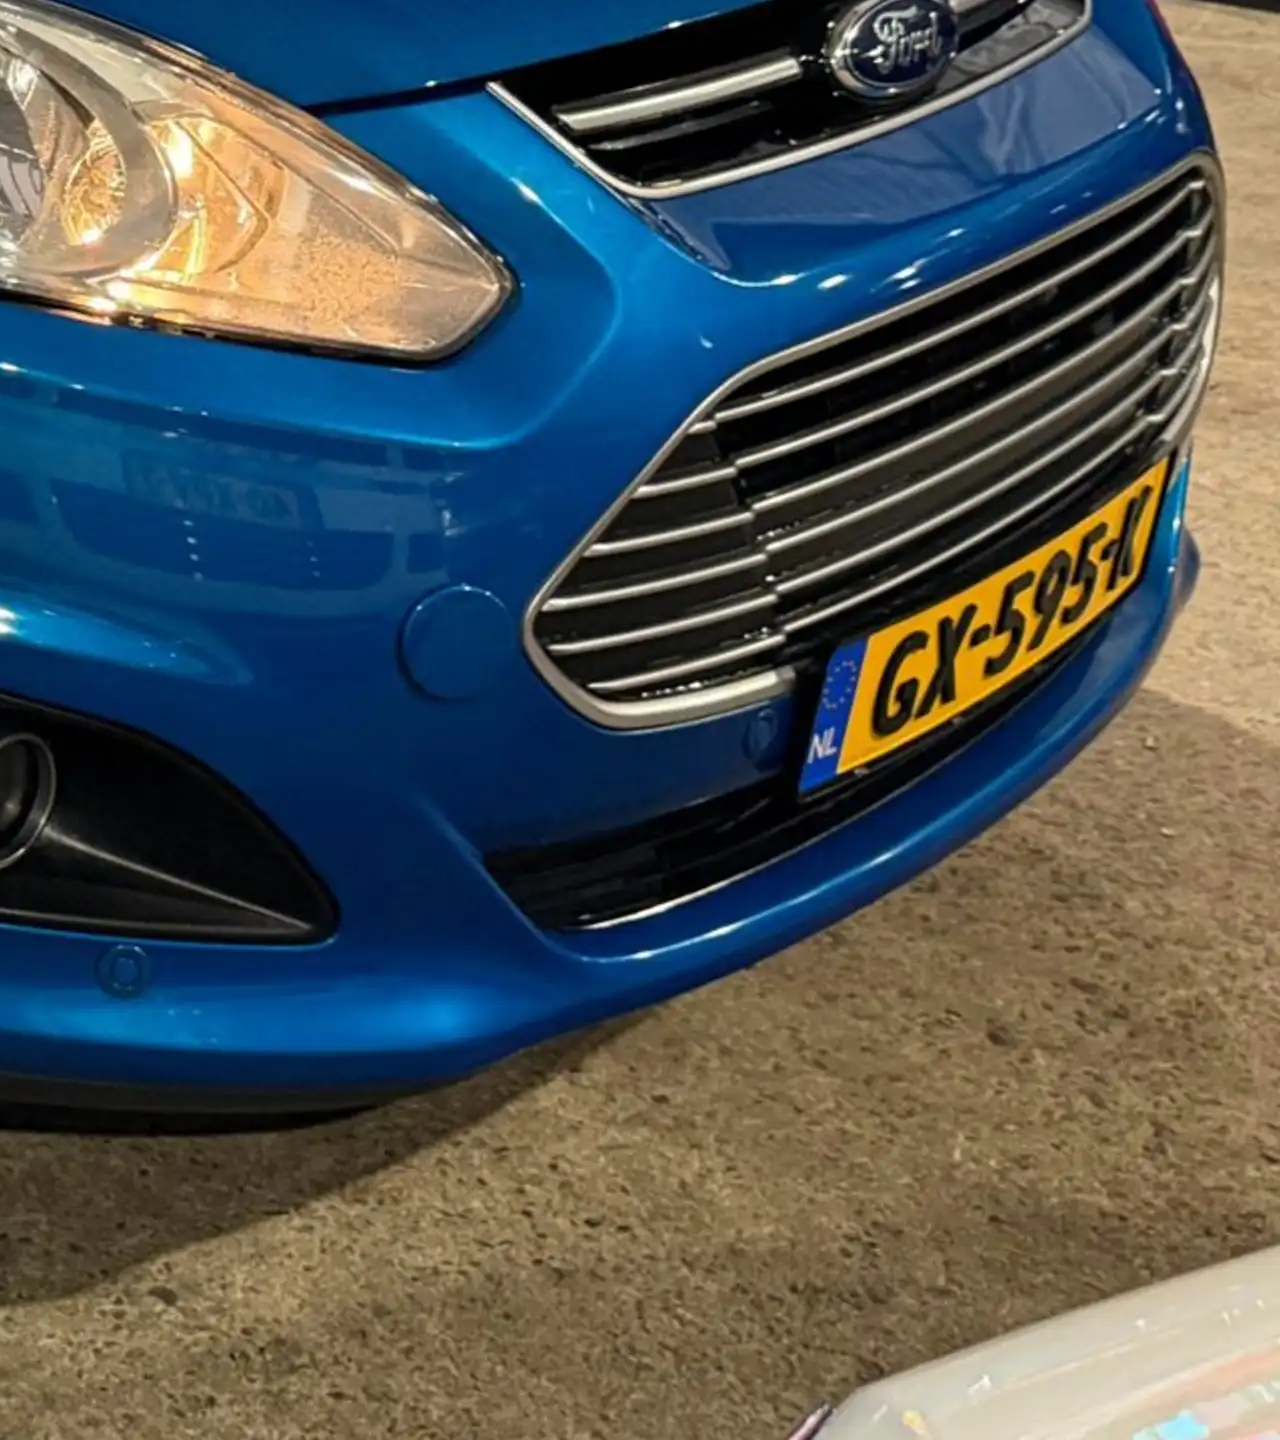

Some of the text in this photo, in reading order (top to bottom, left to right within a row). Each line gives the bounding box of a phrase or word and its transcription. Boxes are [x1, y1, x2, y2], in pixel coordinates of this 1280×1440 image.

[861, 5, 942, 75] Ford
[871, 485, 1153, 737] GX-595-K
[807, 725, 838, 764] NL
